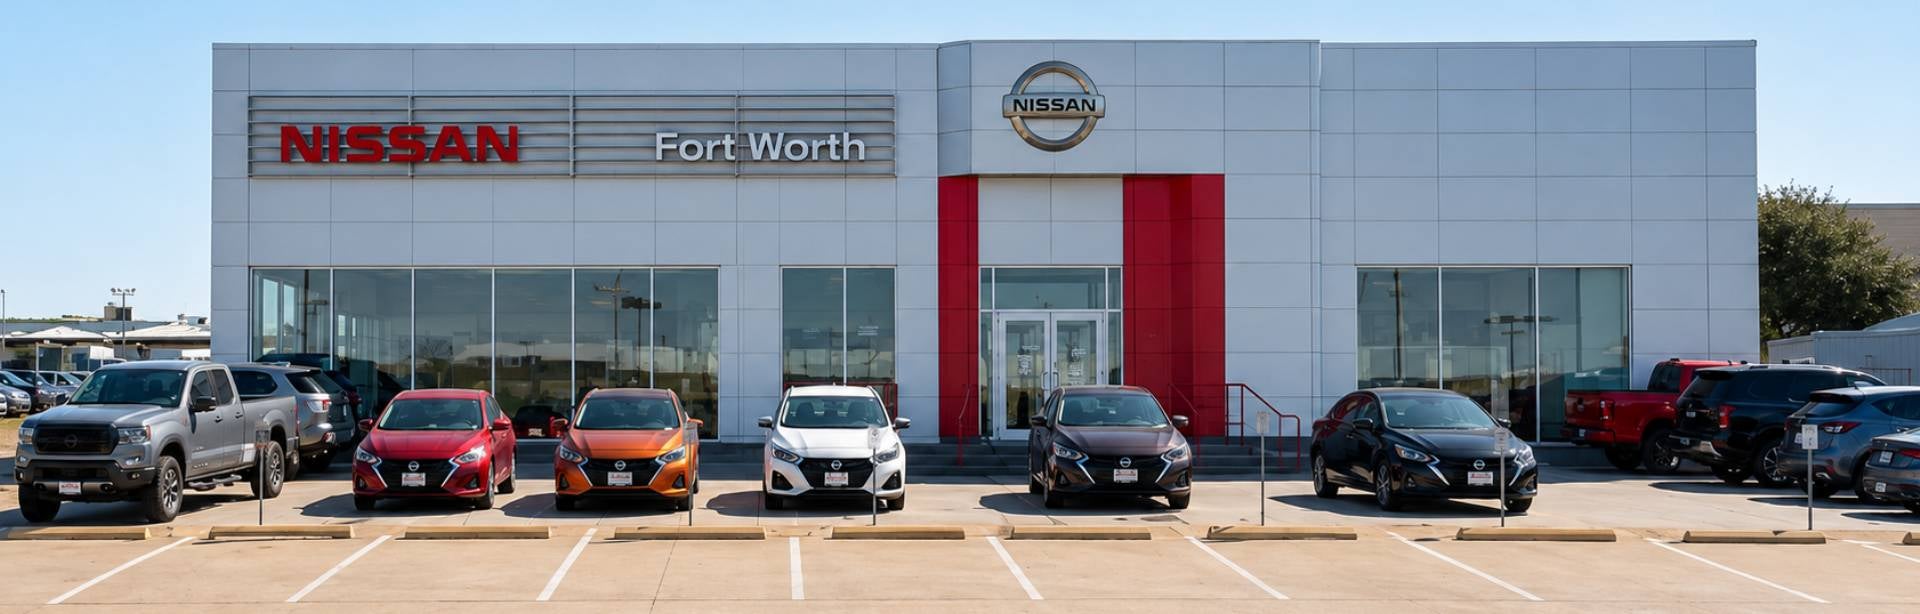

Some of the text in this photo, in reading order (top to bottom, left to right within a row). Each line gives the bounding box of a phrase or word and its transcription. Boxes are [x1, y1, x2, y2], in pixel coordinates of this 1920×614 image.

[1013, 98, 1096, 112] NISSAN
[280, 125, 519, 163] NISSAN
[656, 131, 865, 161] Fort Worth
